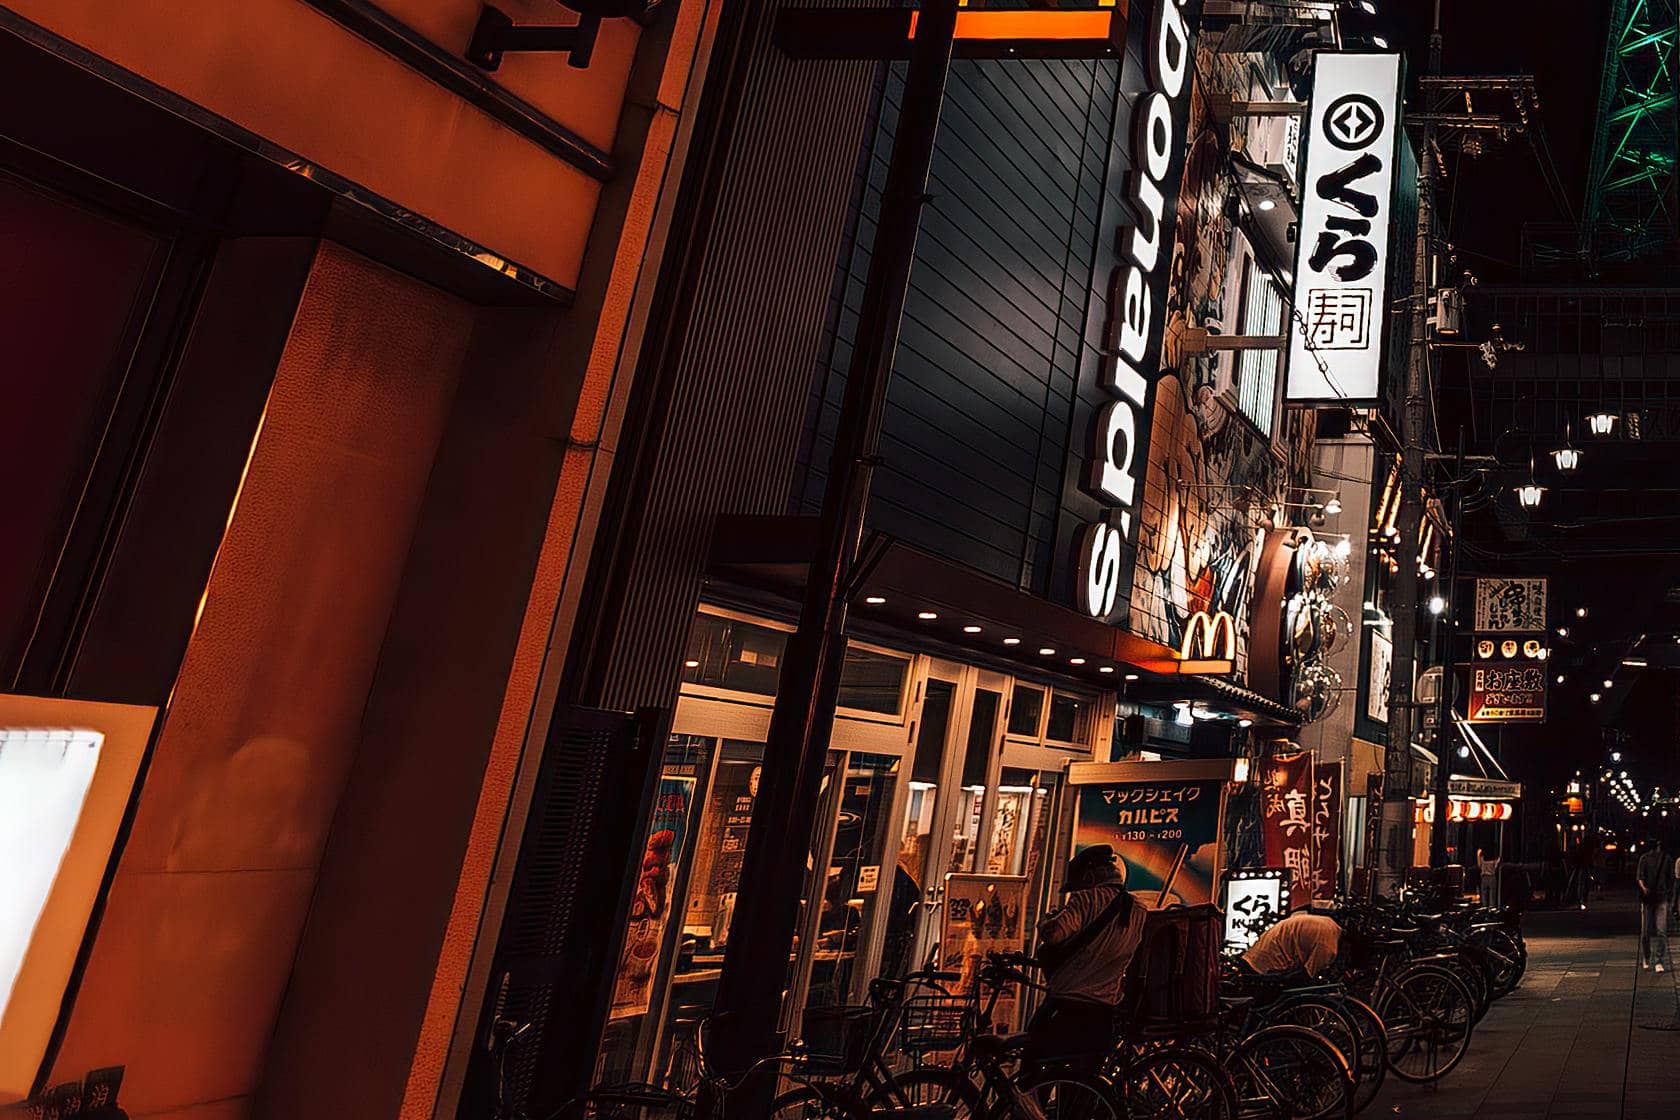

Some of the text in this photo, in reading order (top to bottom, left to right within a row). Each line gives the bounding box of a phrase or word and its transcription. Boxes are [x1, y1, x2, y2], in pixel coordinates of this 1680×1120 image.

[1307, 151, 1383, 283] くら
[1102, 786, 1200, 804] マックシェイク
[1119, 807, 1180, 825] カルピス
[1232, 894, 1271, 917] くら
